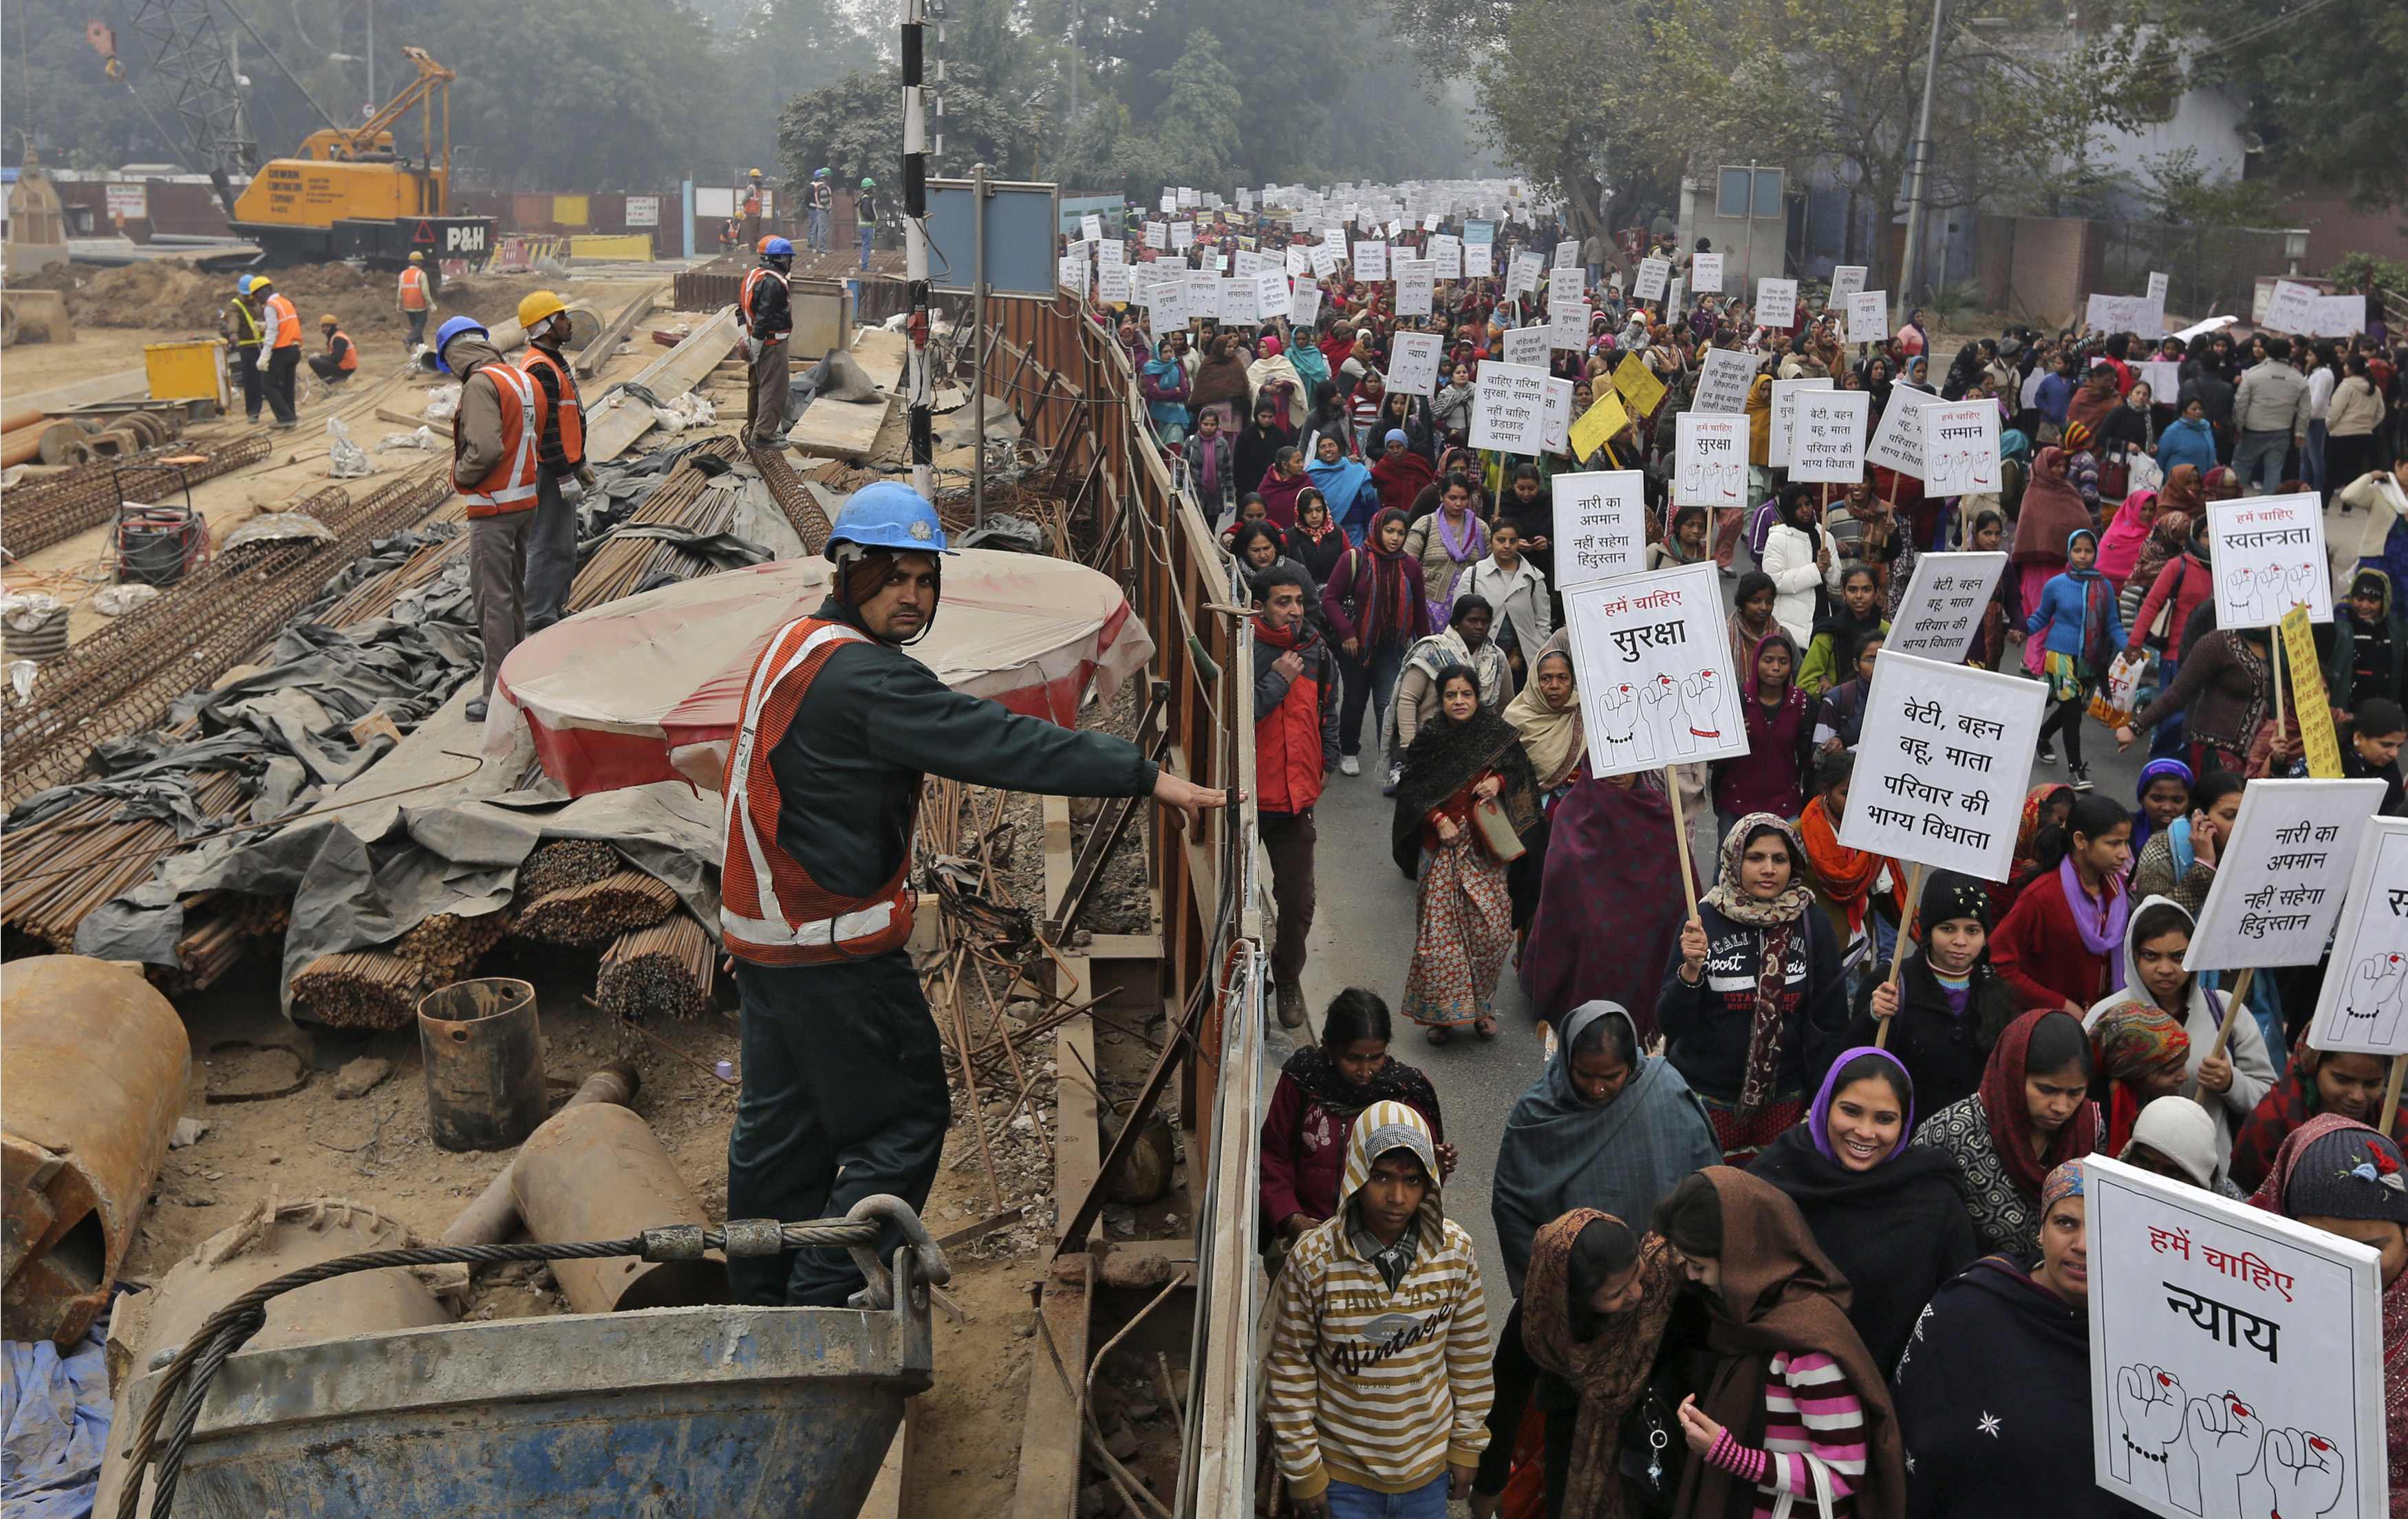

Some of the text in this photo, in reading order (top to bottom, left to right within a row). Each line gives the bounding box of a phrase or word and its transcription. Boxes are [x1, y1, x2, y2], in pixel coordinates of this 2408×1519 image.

[447, 226, 484, 250] P&H
[1159, 296, 1177, 307] सुरक्षा
[1562, 315, 1580, 325] सुरक्षा
[1408, 349, 1427, 359] न्याय
[1486, 374, 1540, 389] चाहिए गरिमा
[1483, 388, 1541, 402] सुरक्षा, सम्मान
[1486, 404, 1531, 420] नहीं चाहिए
[1810, 407, 1853, 420] बेटी, बहन
[1941, 411, 1980, 421] हमें चाहिए
[1696, 422, 1733, 433] हमें चाहिए
[1811, 425, 1851, 438] बहू, माता
[1939, 426, 1982, 440] सम्मान
[1490, 431, 1521, 443] अपमान
[1697, 438, 1731, 455] सुरक्षा
[1806, 442, 1852, 454] परिवार की
[1801, 457, 1855, 469] भाग्य विधाता
[1577, 494, 1621, 510] नारी का
[1580, 513, 1620, 526] अपमान
[2236, 508, 2294, 524] हमें चाहिए
[1573, 533, 1628, 552] नहीं सहेगा
[2223, 528, 2310, 550] स्वतन्त्रता
[1933, 576, 1984, 592] बेटी, बहन
[1602, 590, 1682, 617] हमें चाहिए
[1926, 596, 1974, 612] बहू, माता
[1915, 616, 1968, 632] परिवार की
[1609, 619, 1686, 663] सुरक्षा
[1902, 635, 1964, 649] भाग्य विधाता
[1904, 696, 2005, 741] बेटी, बहन
[1900, 735, 1993, 773] बहू, माता
[1884, 773, 1990, 816] परिवार की
[1867, 805, 1991, 850] भाग्य विधाता
[2275, 820, 2340, 845] नारी का
[2266, 852, 2328, 871] अपमान
[2244, 883, 2326, 914] नहीं सहेगा
[2147, 1225, 2294, 1303] हमें चाहिए
[2162, 1281, 2281, 1364] न्याय
[1331, 1302, 1452, 1377] Vintage
